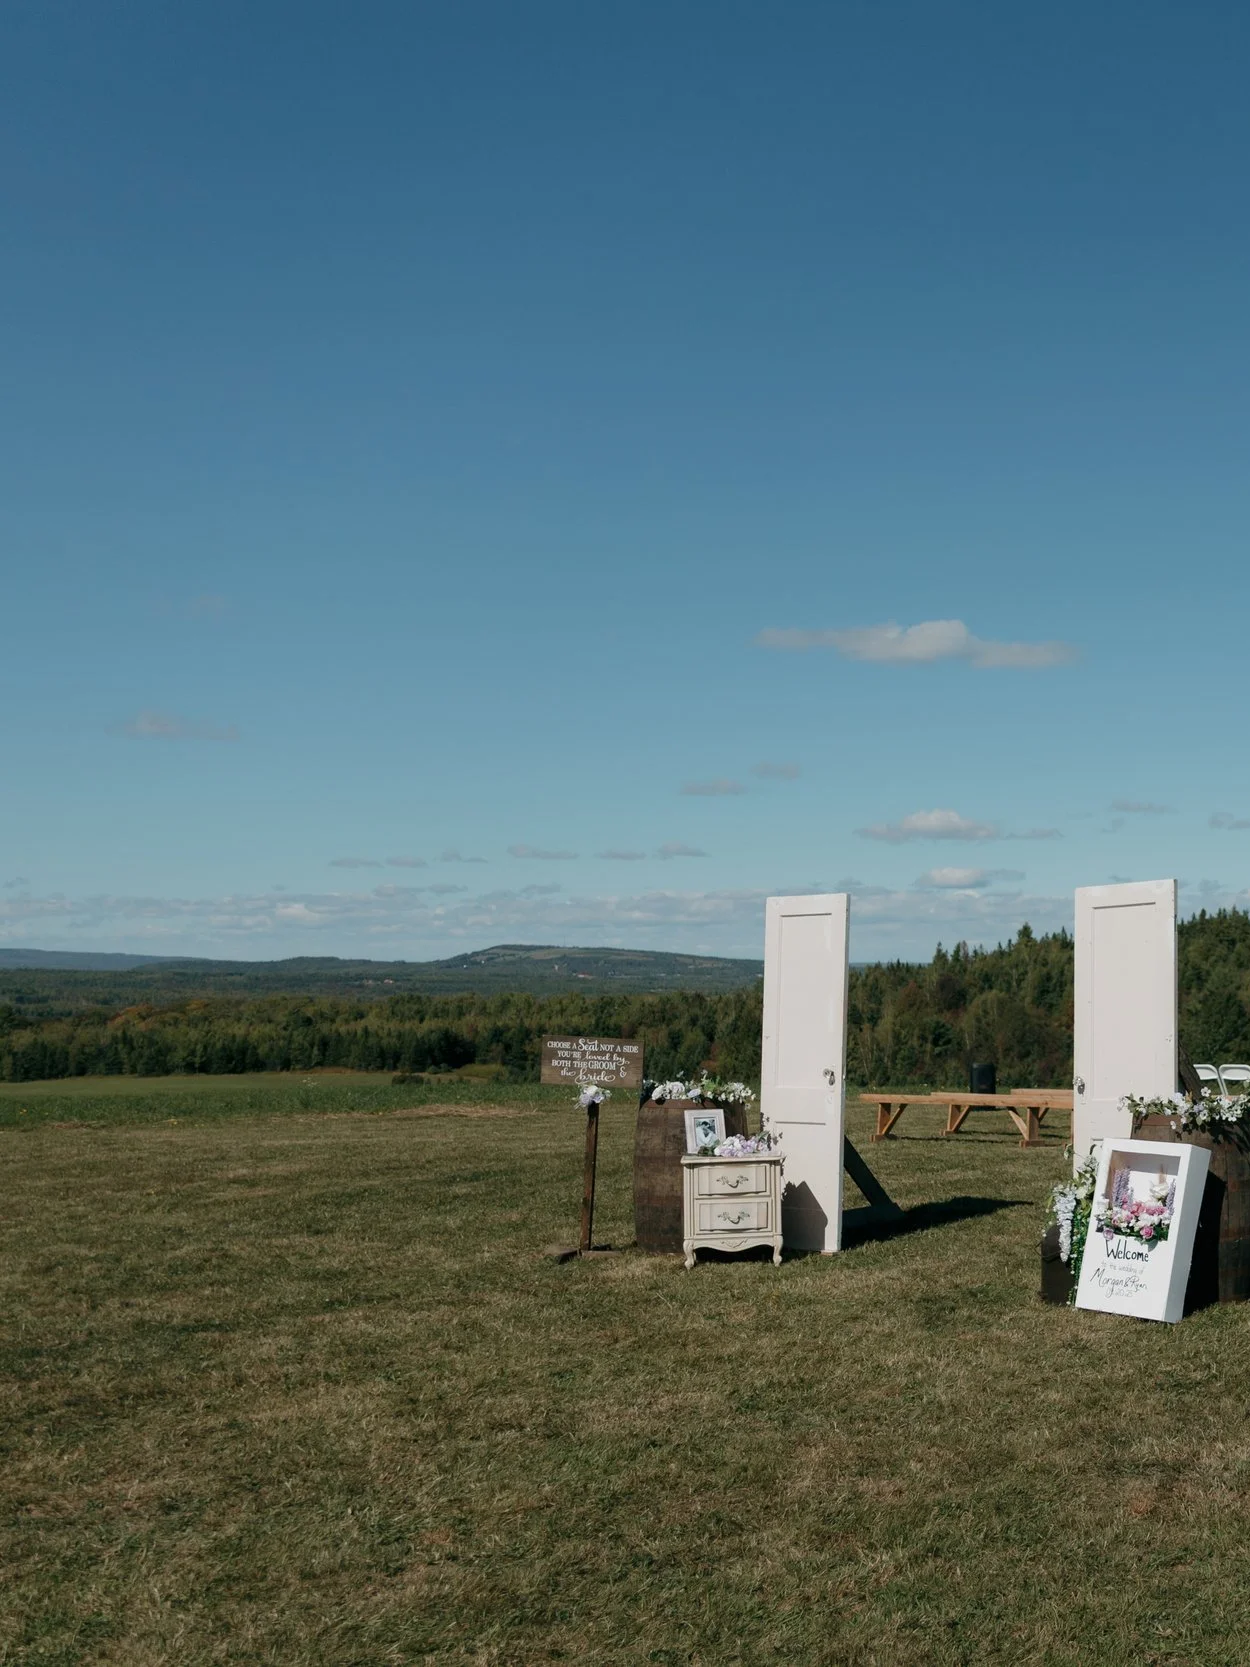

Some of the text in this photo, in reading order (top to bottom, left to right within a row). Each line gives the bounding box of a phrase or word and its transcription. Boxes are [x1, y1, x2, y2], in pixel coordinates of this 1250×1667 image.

[547, 1041, 571, 1049] CHOOSE
[578, 1038, 599, 1051] Seat
[623, 1045, 639, 1053] SIDE
[583, 1051, 611, 1061] loved
[552, 1059, 571, 1067] BOTH
[573, 1060, 587, 1068] THE
[588, 1060, 616, 1070] GROOM
[561, 1067, 616, 1085] the bride
[1106, 1239, 1149, 1262] Welcome
